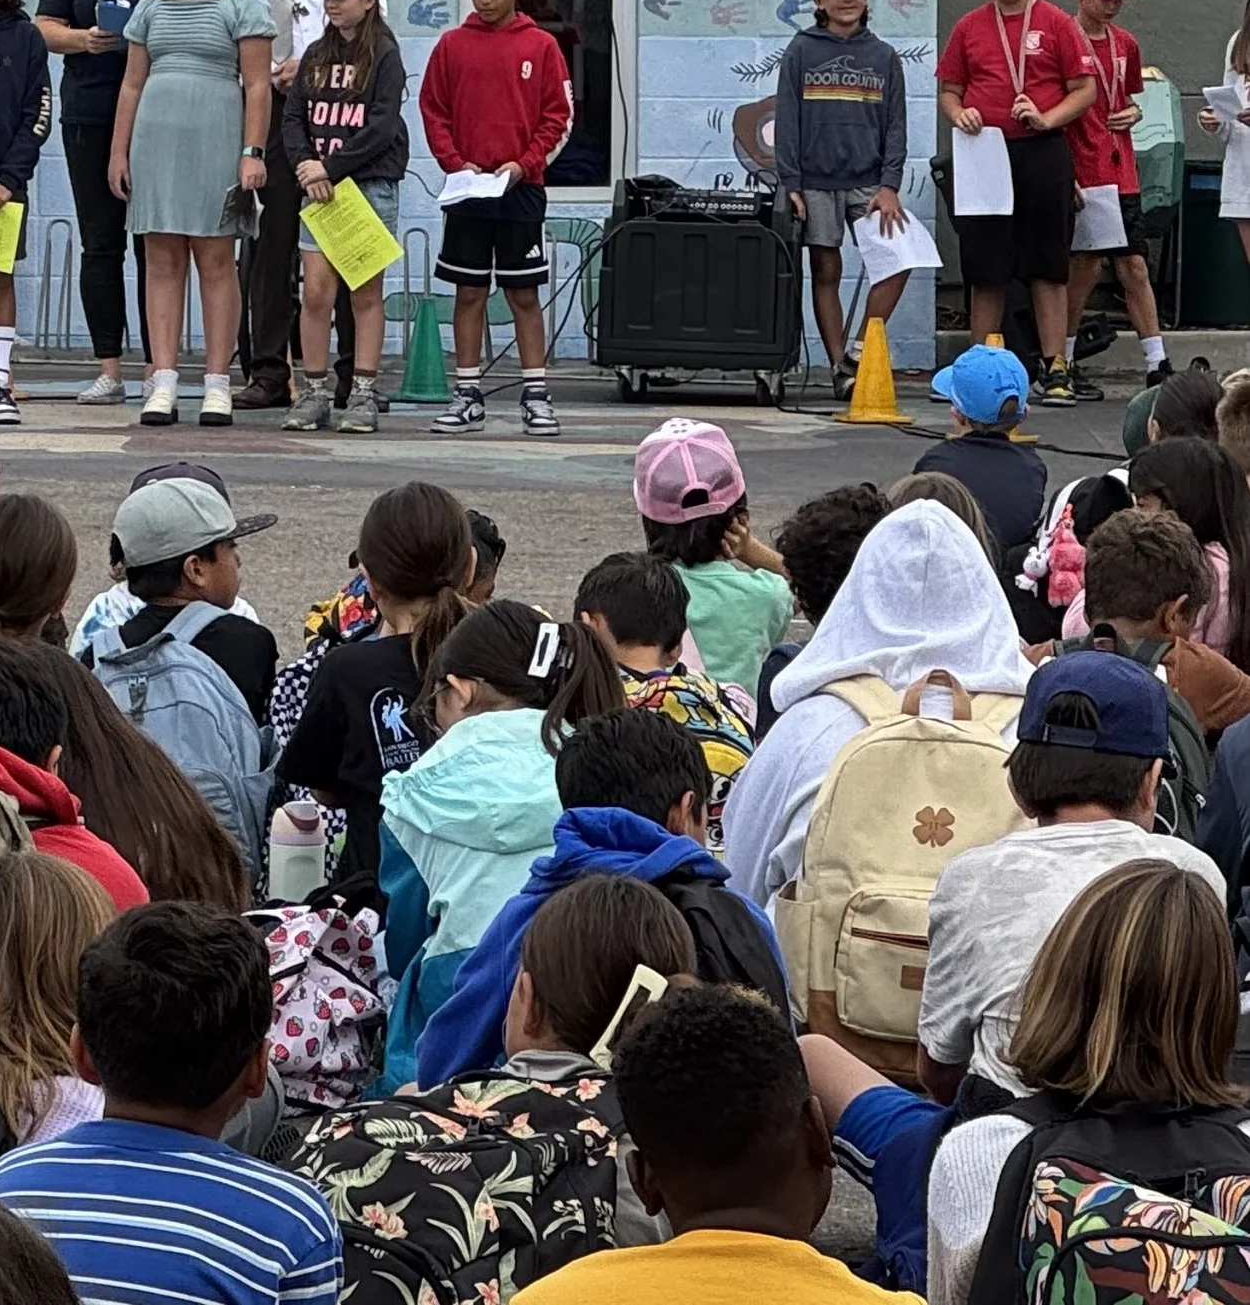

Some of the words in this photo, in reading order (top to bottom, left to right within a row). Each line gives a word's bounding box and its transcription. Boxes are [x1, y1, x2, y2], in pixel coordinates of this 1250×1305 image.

[521, 60, 533, 80] 9
[804, 72, 839, 86] DOOR
[841, 73, 886, 90] COUNTY
